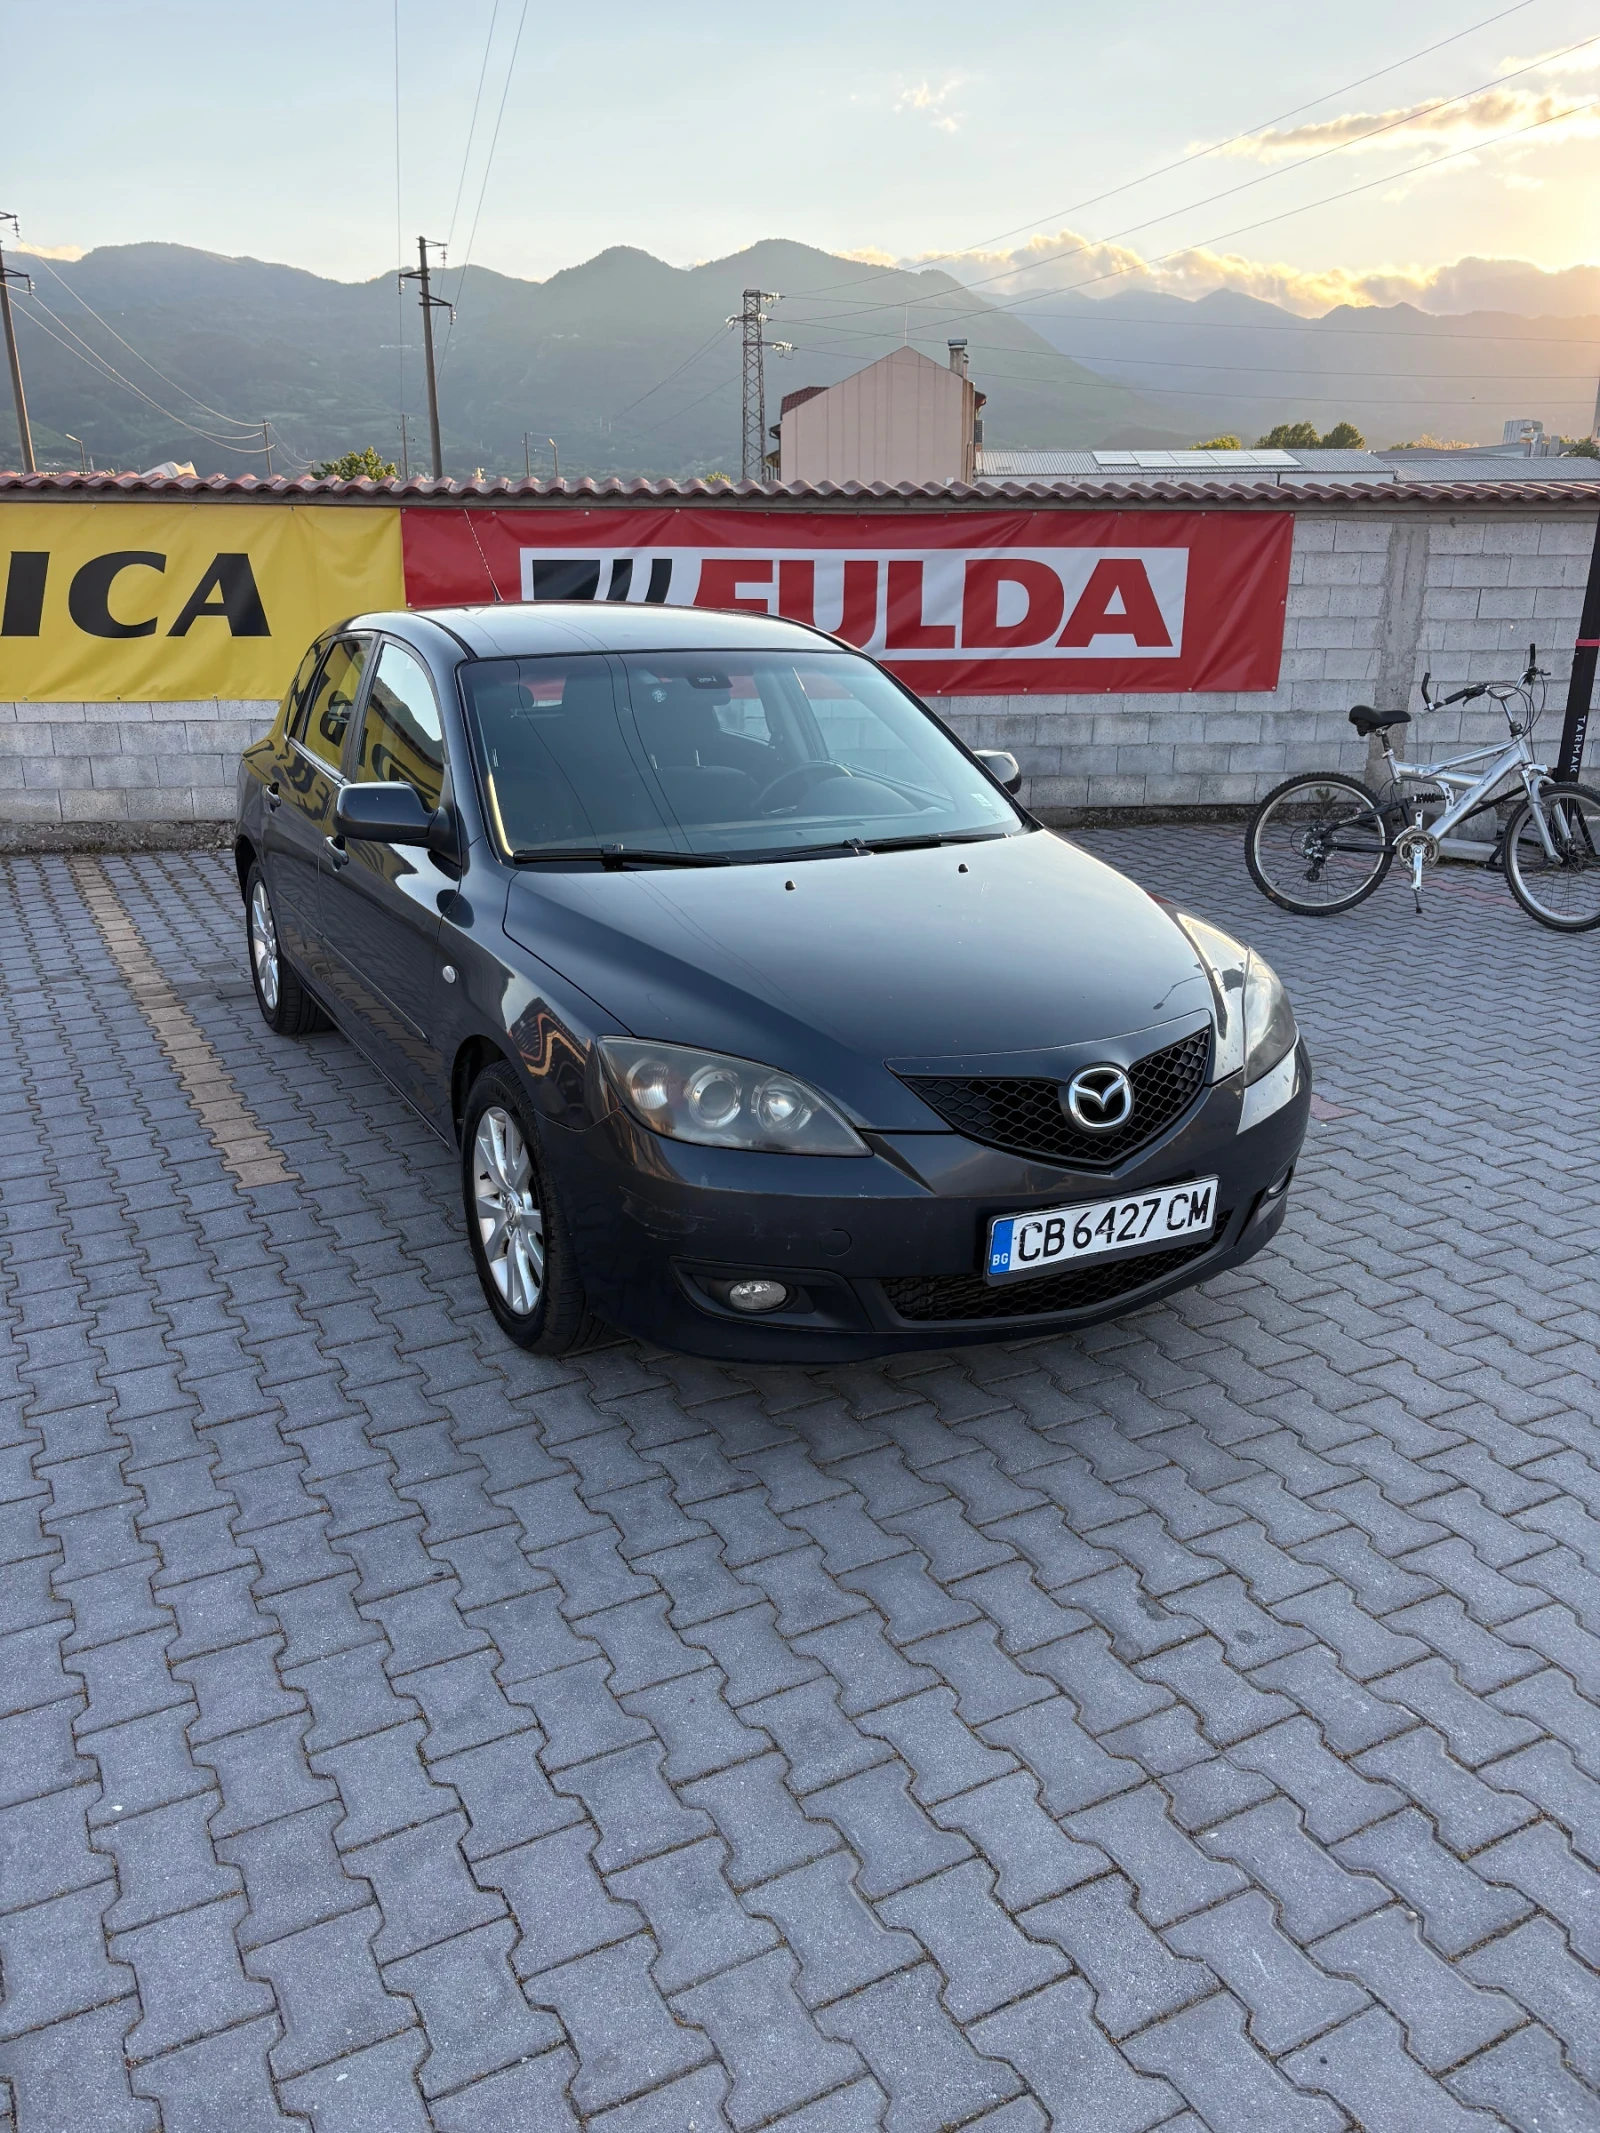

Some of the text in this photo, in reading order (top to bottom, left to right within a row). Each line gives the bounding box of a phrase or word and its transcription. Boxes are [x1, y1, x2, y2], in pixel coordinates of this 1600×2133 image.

[0, 550, 271, 639] ICA
[691, 558, 1172, 650] FULDA
[1569, 715, 1587, 773] TARMAK
[992, 1253, 1009, 1266] BG
